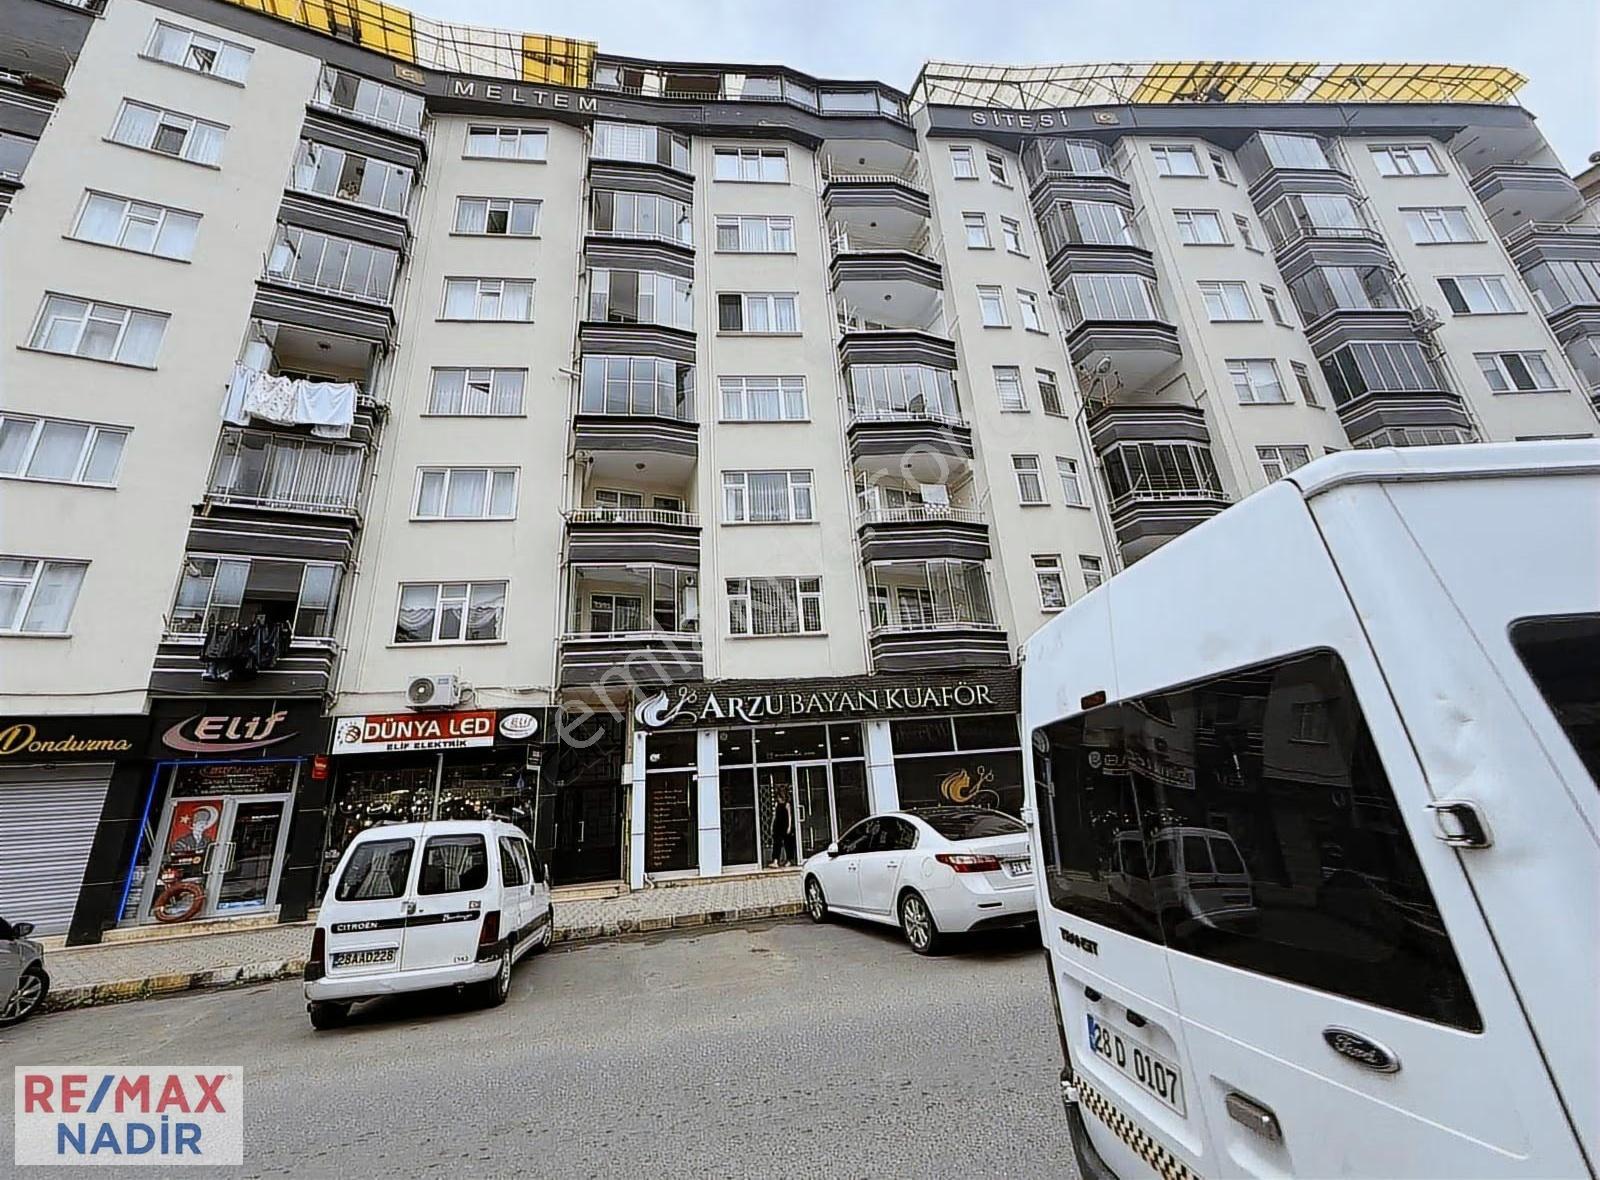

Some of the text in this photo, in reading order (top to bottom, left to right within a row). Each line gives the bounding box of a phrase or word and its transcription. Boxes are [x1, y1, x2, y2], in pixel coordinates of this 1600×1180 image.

[454, 78, 599, 113] MELTEM
[970, 108, 1069, 130] SİTESİ
[700, 682, 994, 723] ARZU BAYAN KUAFÖR
[0, 724, 132, 755] Dondurma
[364, 717, 490, 741] DÜNYA LED
[387, 739, 467, 751] ELİF ELEKTRİK
[1095, 1025, 1178, 1104] 28 D 0107
